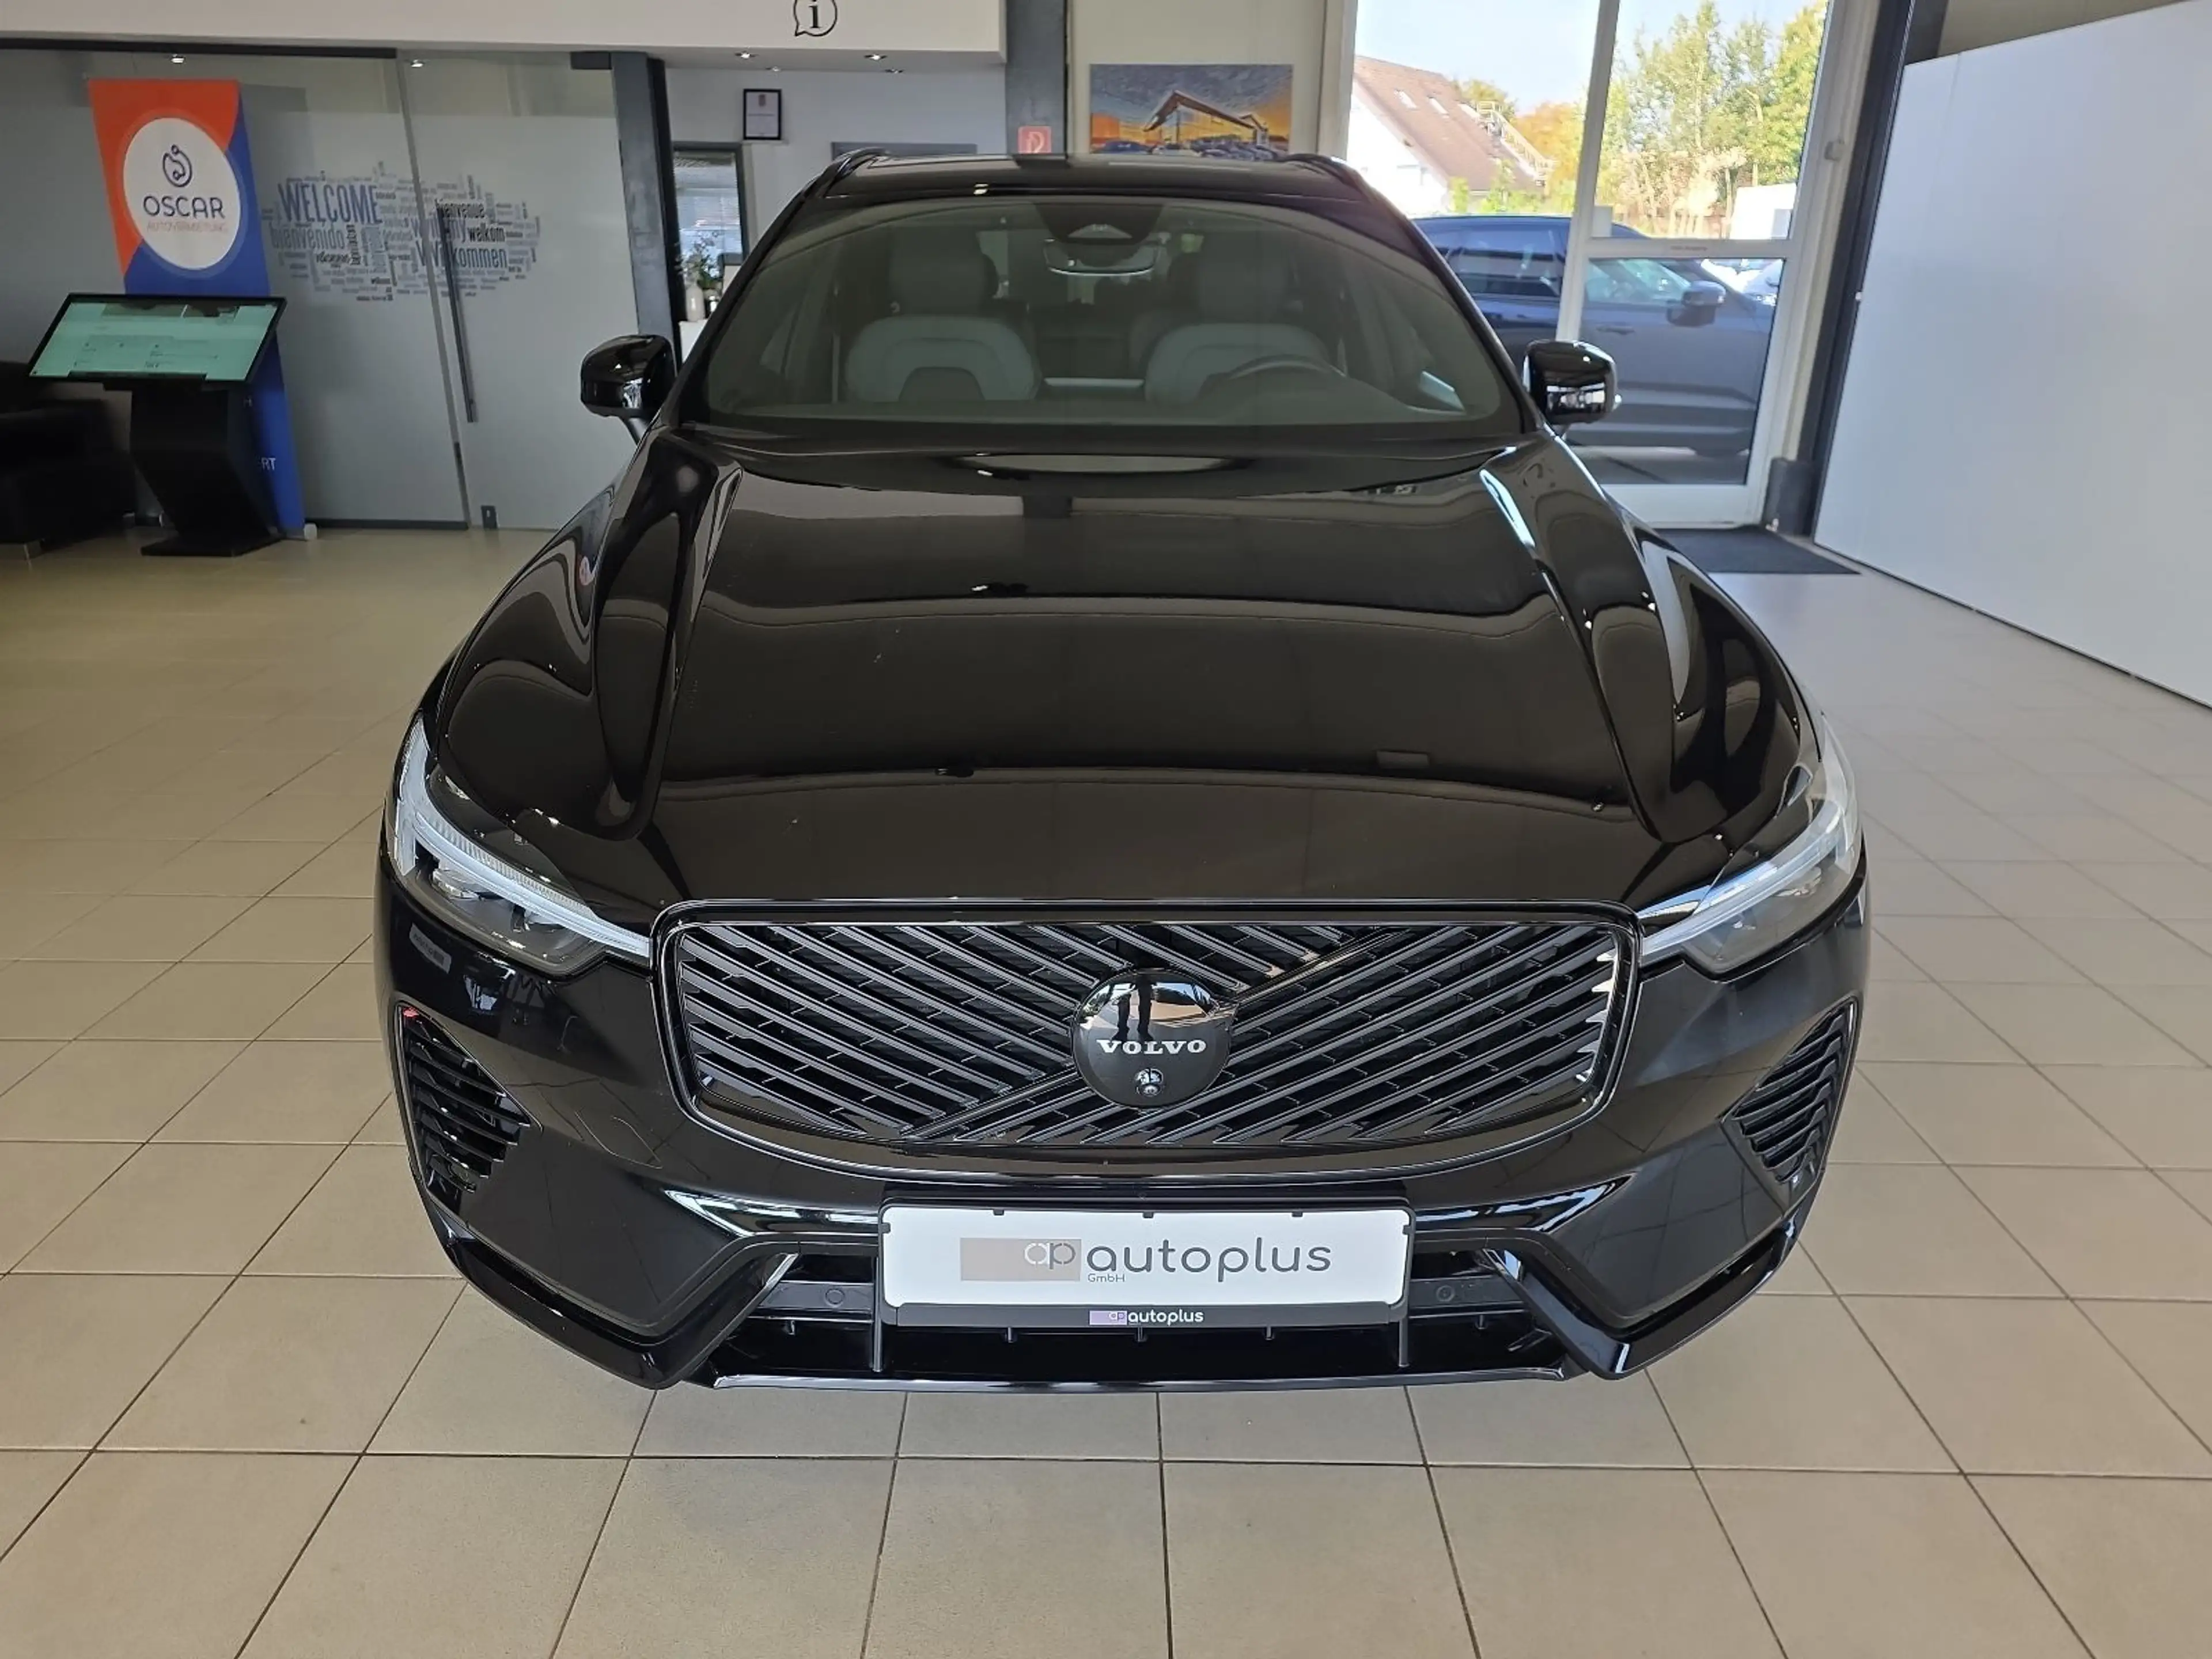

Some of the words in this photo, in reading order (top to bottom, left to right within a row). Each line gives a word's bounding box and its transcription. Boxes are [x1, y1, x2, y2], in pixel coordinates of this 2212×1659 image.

[143, 195, 225, 219] OSCAR
[278, 183, 383, 225] WELCOME
[269, 222, 346, 250] bienvenido
[1097, 1039, 1207, 1055] VOLVO
[1086, 1237, 1331, 1282] autoplus
[1087, 1273, 1125, 1283] GmbH
[1128, 1309, 1204, 1326] autoplus
